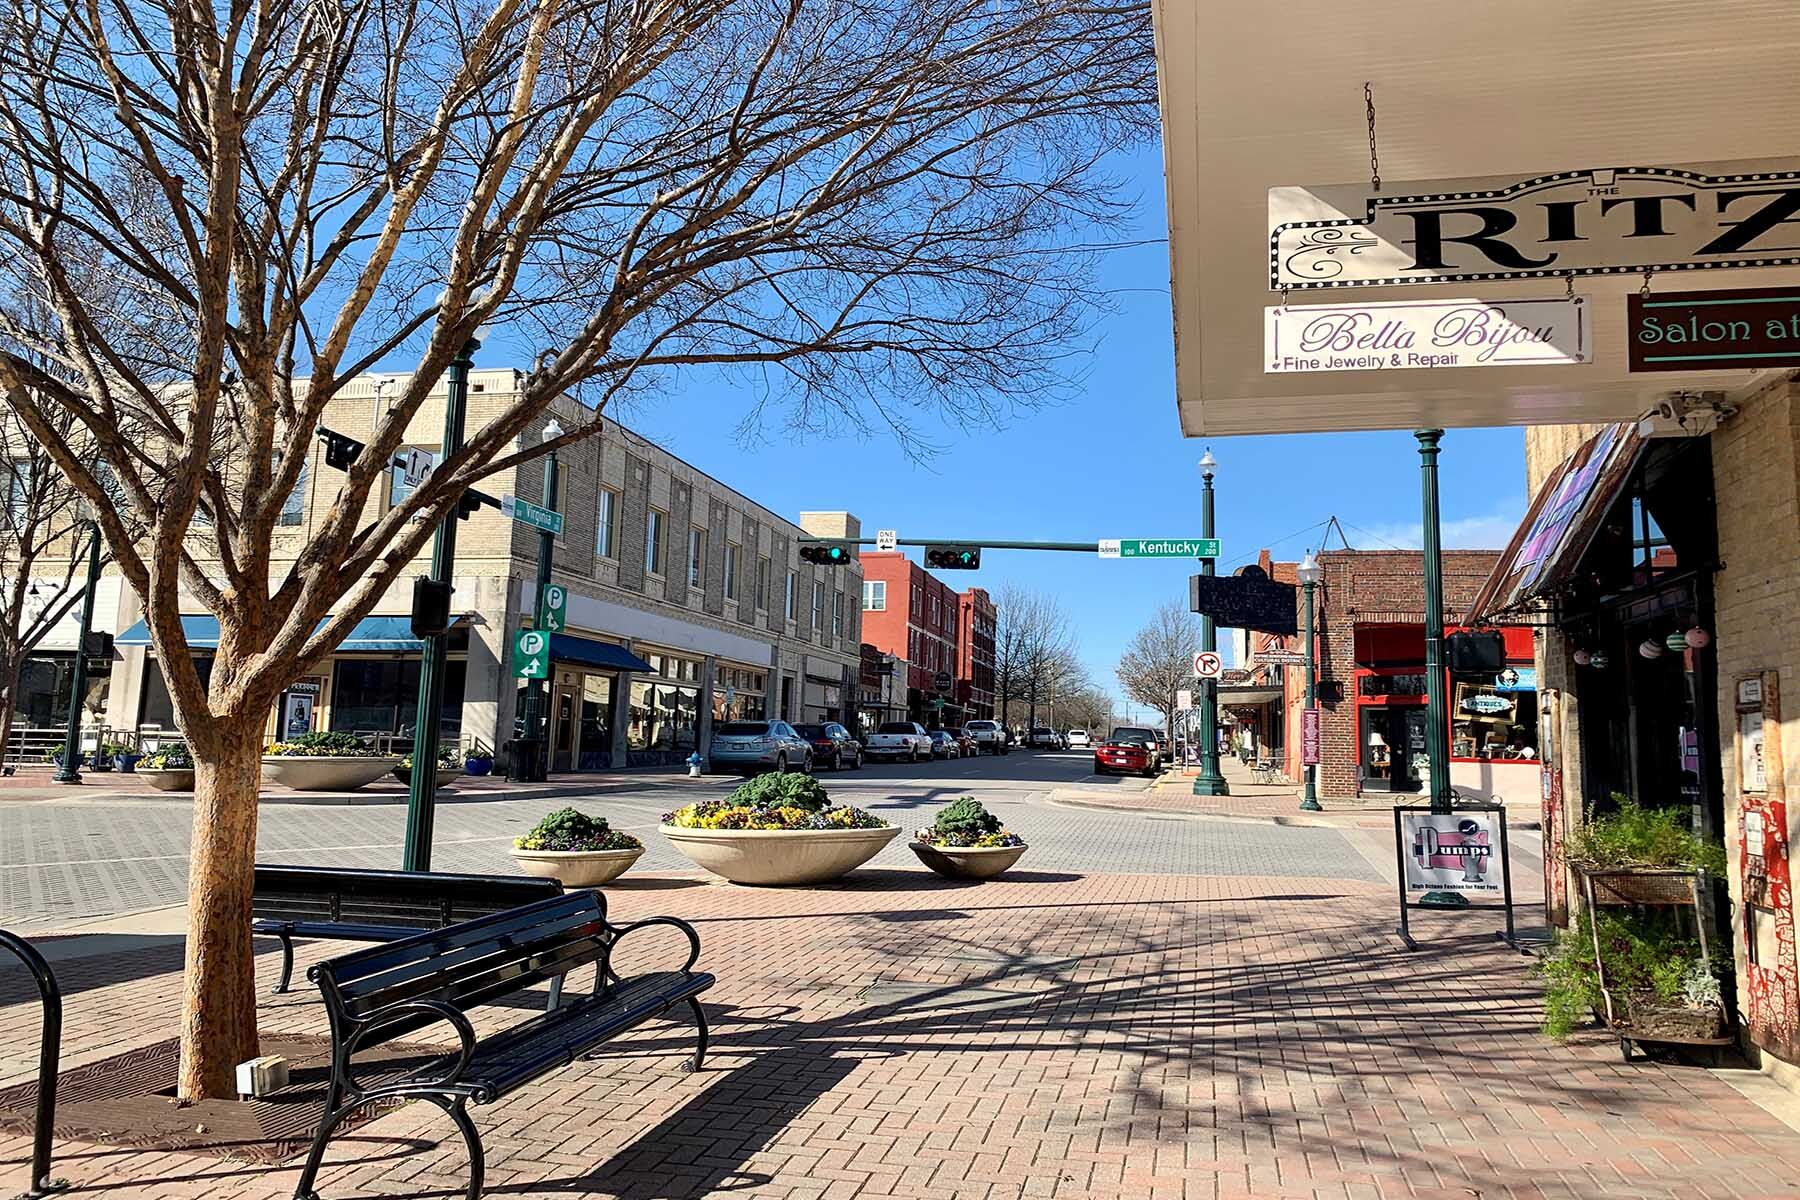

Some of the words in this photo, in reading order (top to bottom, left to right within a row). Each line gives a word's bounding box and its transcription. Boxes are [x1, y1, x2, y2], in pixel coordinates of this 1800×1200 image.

[1587, 187, 1620, 196] THE
[1394, 186, 1800, 269] RITZ
[1299, 312, 1416, 352] Bella
[1431, 307, 1553, 362] Bijou
[1638, 316, 1751, 344] Salon
[1765, 313, 1800, 339] at
[1284, 356, 1320, 370] Fine
[1325, 353, 1386, 370] Jewelry
[1390, 353, 1401, 367] &
[1407, 352, 1459, 368] Repair
[526, 502, 552, 525] Virginia
[1124, 548, 1135, 556] 100
[1139, 541, 1200, 556] Kentucky
[1209, 541, 1217, 549] St
[551, 589, 560, 606] P
[526, 635, 539, 652] P
[1419, 826, 1490, 869] Pumps
